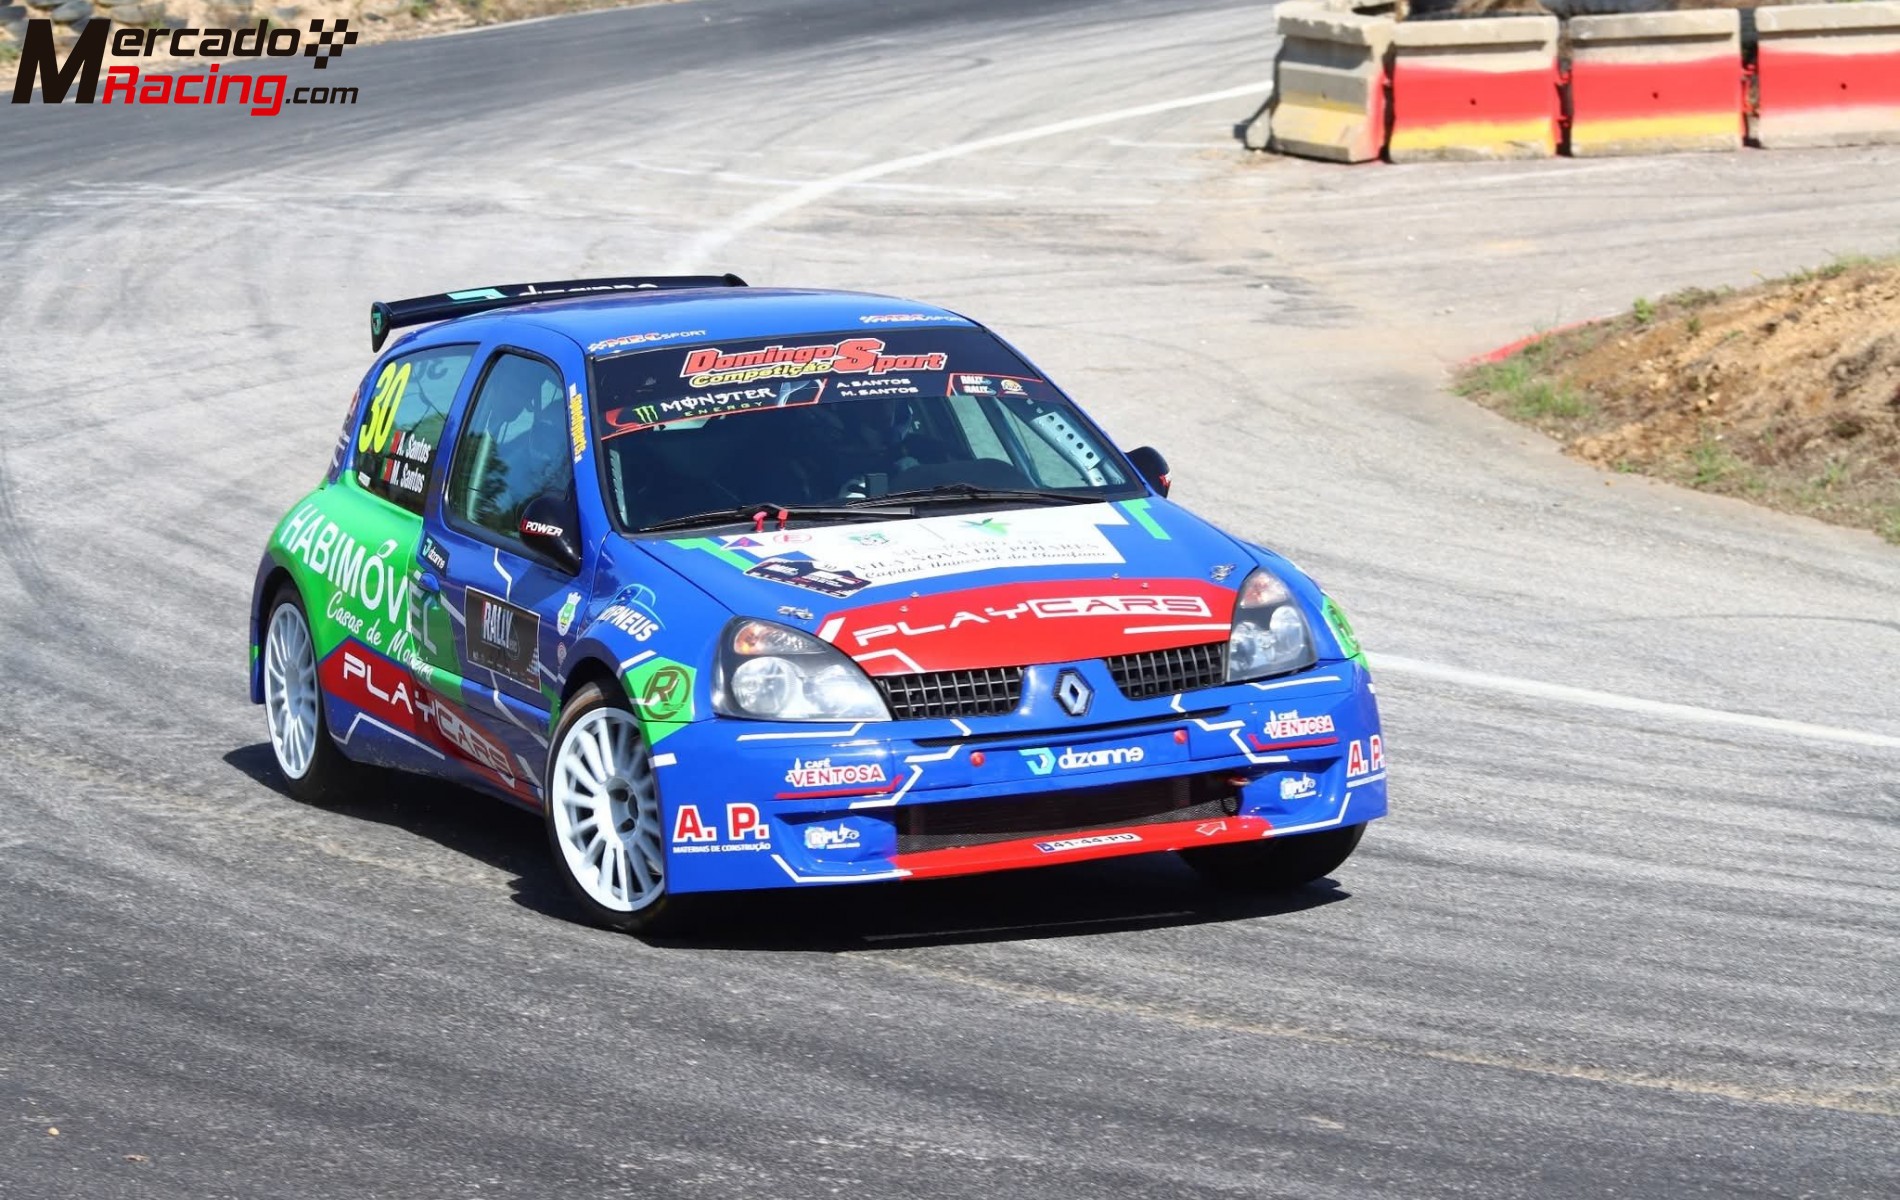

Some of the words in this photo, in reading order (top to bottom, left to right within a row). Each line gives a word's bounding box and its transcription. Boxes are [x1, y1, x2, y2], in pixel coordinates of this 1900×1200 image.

[679, 344, 837, 378] Domingo
[832, 338, 947, 376] Sport
[852, 378, 911, 388] SANTOS
[859, 386, 919, 396] SANTOS
[358, 362, 411, 453] 30
[683, 401, 763, 417] ENERGY
[406, 433, 432, 464] Santos
[400, 462, 425, 494] Santos
[525, 521, 564, 537] POWER
[327, 591, 364, 635] Casas
[366, 618, 382, 646] de
[1269, 715, 1334, 739] VENTOSA
[804, 758, 831, 769] CAFÉ
[1347, 740, 1369, 778] A.
[790, 764, 886, 787] VENTOSA
[673, 804, 717, 842] A.
[726, 802, 770, 840] P.
